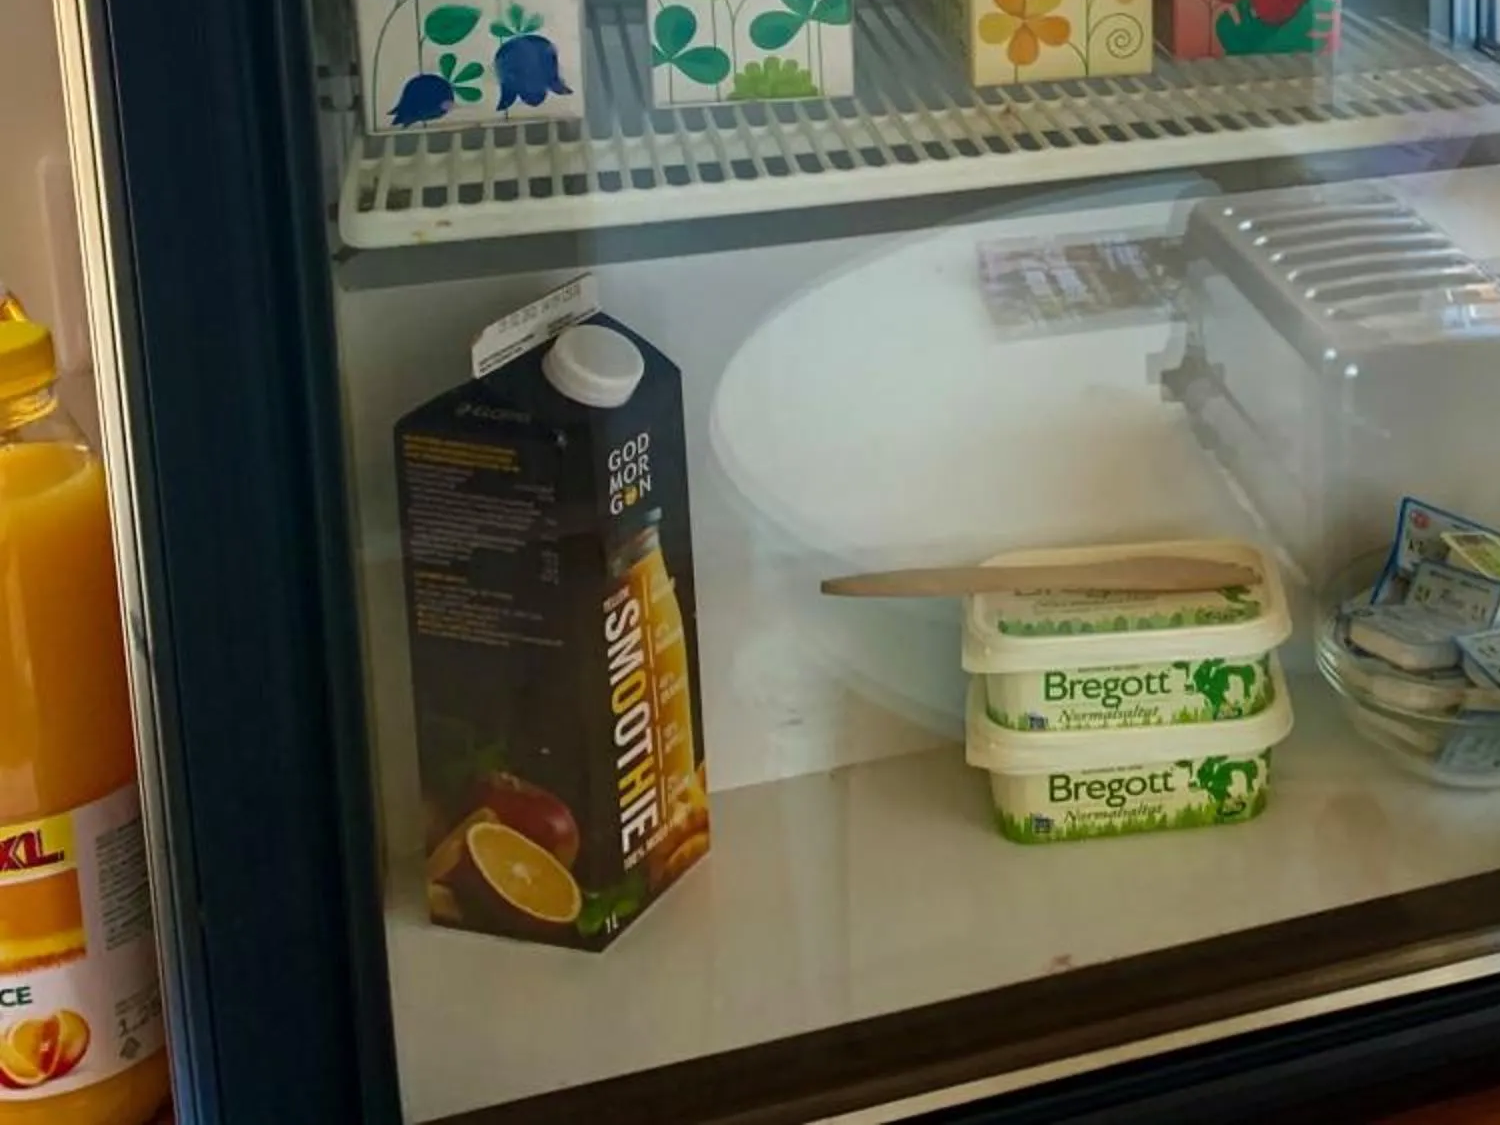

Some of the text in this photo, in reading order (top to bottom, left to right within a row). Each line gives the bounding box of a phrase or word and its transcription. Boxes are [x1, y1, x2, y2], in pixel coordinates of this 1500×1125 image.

[608, 432, 650, 472] GOD
[1044, 670, 1172, 708] Bregott
[605, 598, 660, 853] SMOOTHIE
[1049, 773, 1175, 808] Bregott
